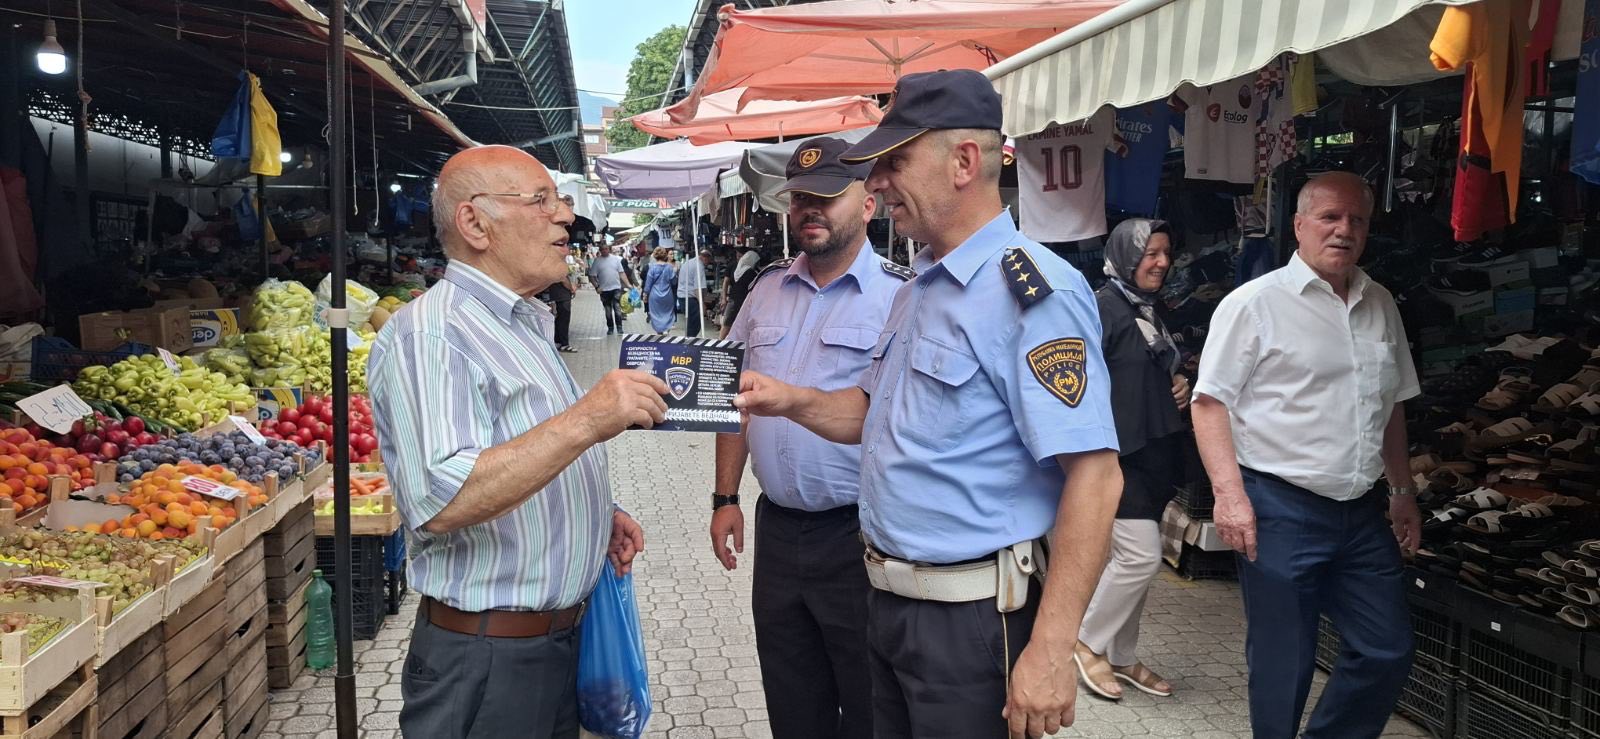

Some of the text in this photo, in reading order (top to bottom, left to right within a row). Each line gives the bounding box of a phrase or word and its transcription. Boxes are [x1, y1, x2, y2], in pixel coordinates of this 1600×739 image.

[1224, 110, 1248, 122] Ecolog
[1063, 123, 1095, 137] YAMAL
[1117, 118, 1153, 134] irates
[1041, 144, 1083, 193] 10
[661, 229, 672, 239] 10
[671, 356, 692, 365] МВР
[1036, 351, 1083, 372] ПОЛИЦИЈА
[1043, 362, 1081, 378] POLICE
